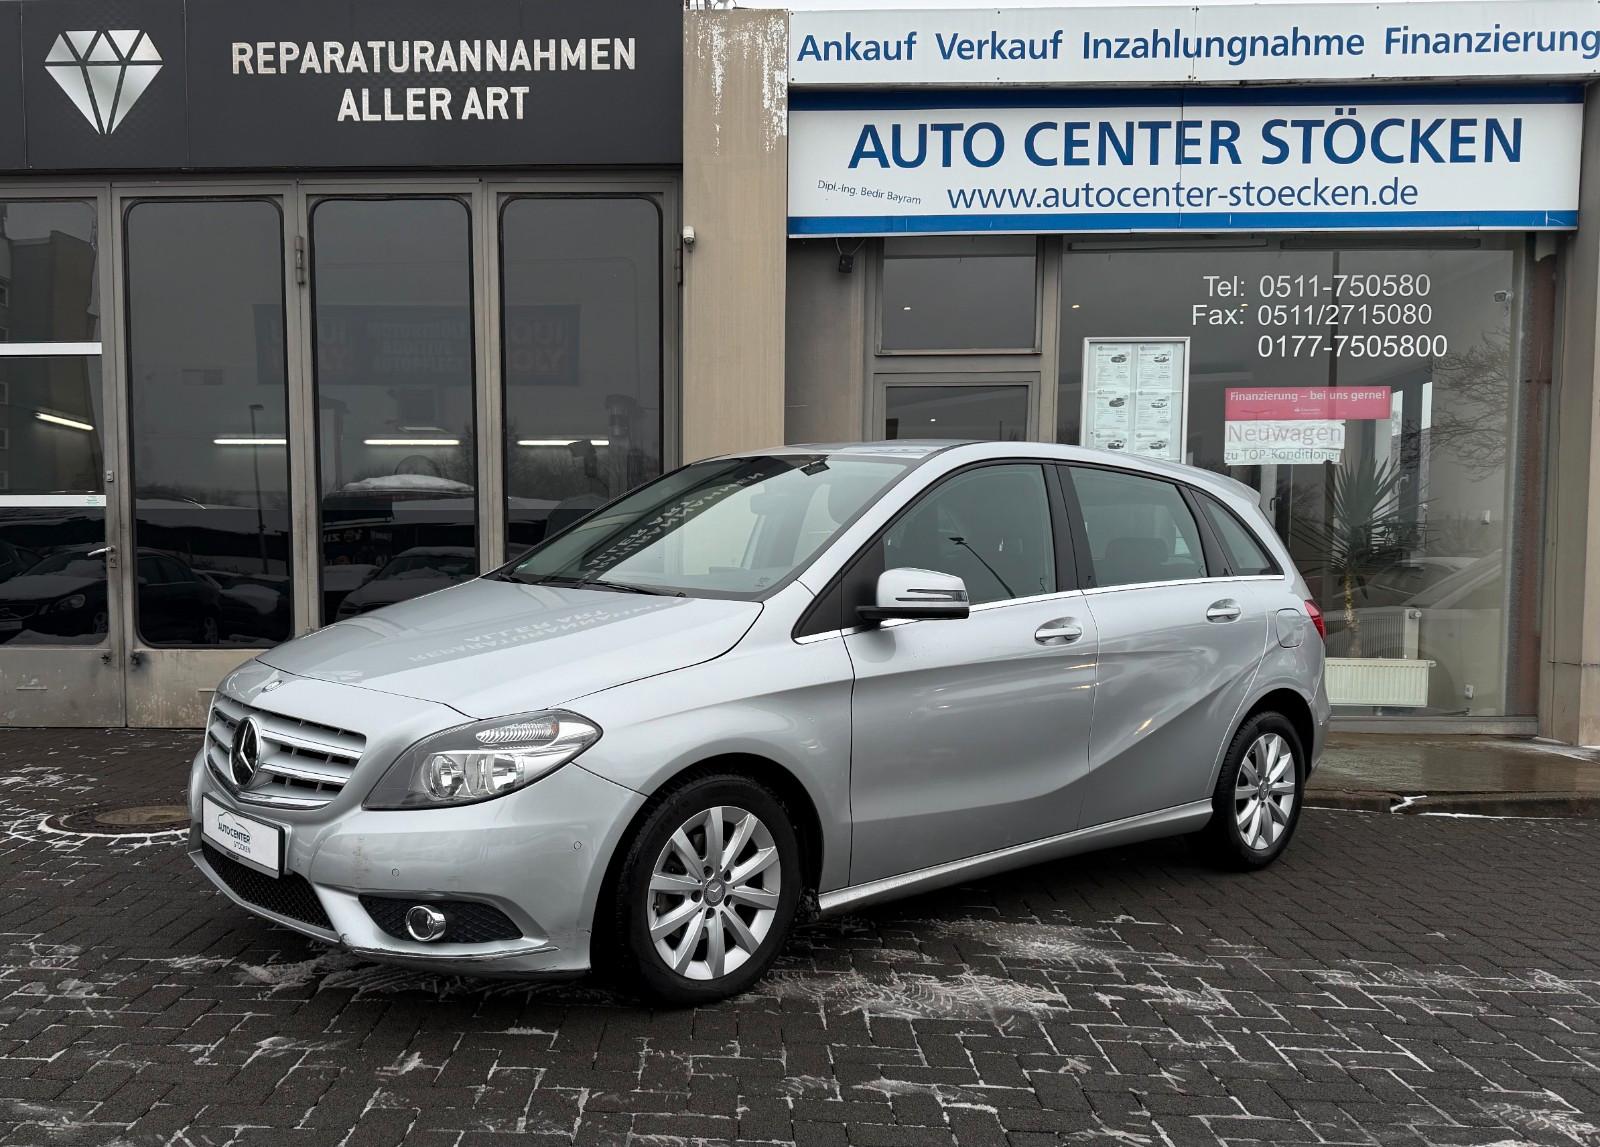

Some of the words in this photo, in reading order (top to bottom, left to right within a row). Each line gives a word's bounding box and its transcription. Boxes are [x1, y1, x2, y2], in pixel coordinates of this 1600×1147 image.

[231, 37, 636, 75] REPARATURANNAHMEN
[796, 31, 917, 62] Ankauf
[935, 29, 1064, 61] Verkauf
[1083, 26, 1365, 66] Inzahlungnahme
[1385, 23, 1600, 60] Finanzierung
[337, 87, 453, 122] ALLER
[461, 86, 530, 121] ART
[847, 121, 1005, 169] AUTO
[1024, 120, 1242, 167] CENTER
[1261, 106, 1523, 165] STÖCKEN
[817, 180, 858, 197] Dipl.-Ing.
[886, 191, 922, 205] Bayram
[947, 176, 1418, 209] www.autocenter-stoecken.de
[1203, 275, 1246, 297] Tel:
[1259, 274, 1431, 298] 0511-750580
[1192, 304, 1246, 326] Fax:
[1257, 303, 1433, 326] 0511/2715080
[1257, 334, 1448, 358] 0177-7505800
[1230, 391, 1298, 402] Finanzierung
[1310, 390, 1326, 400] bei
[1351, 390, 1386, 402] gerne!
[1228, 424, 1343, 445] Neuwagen
[1225, 452, 1238, 461] zu
[218, 822, 251, 844] AUTOCENTER
